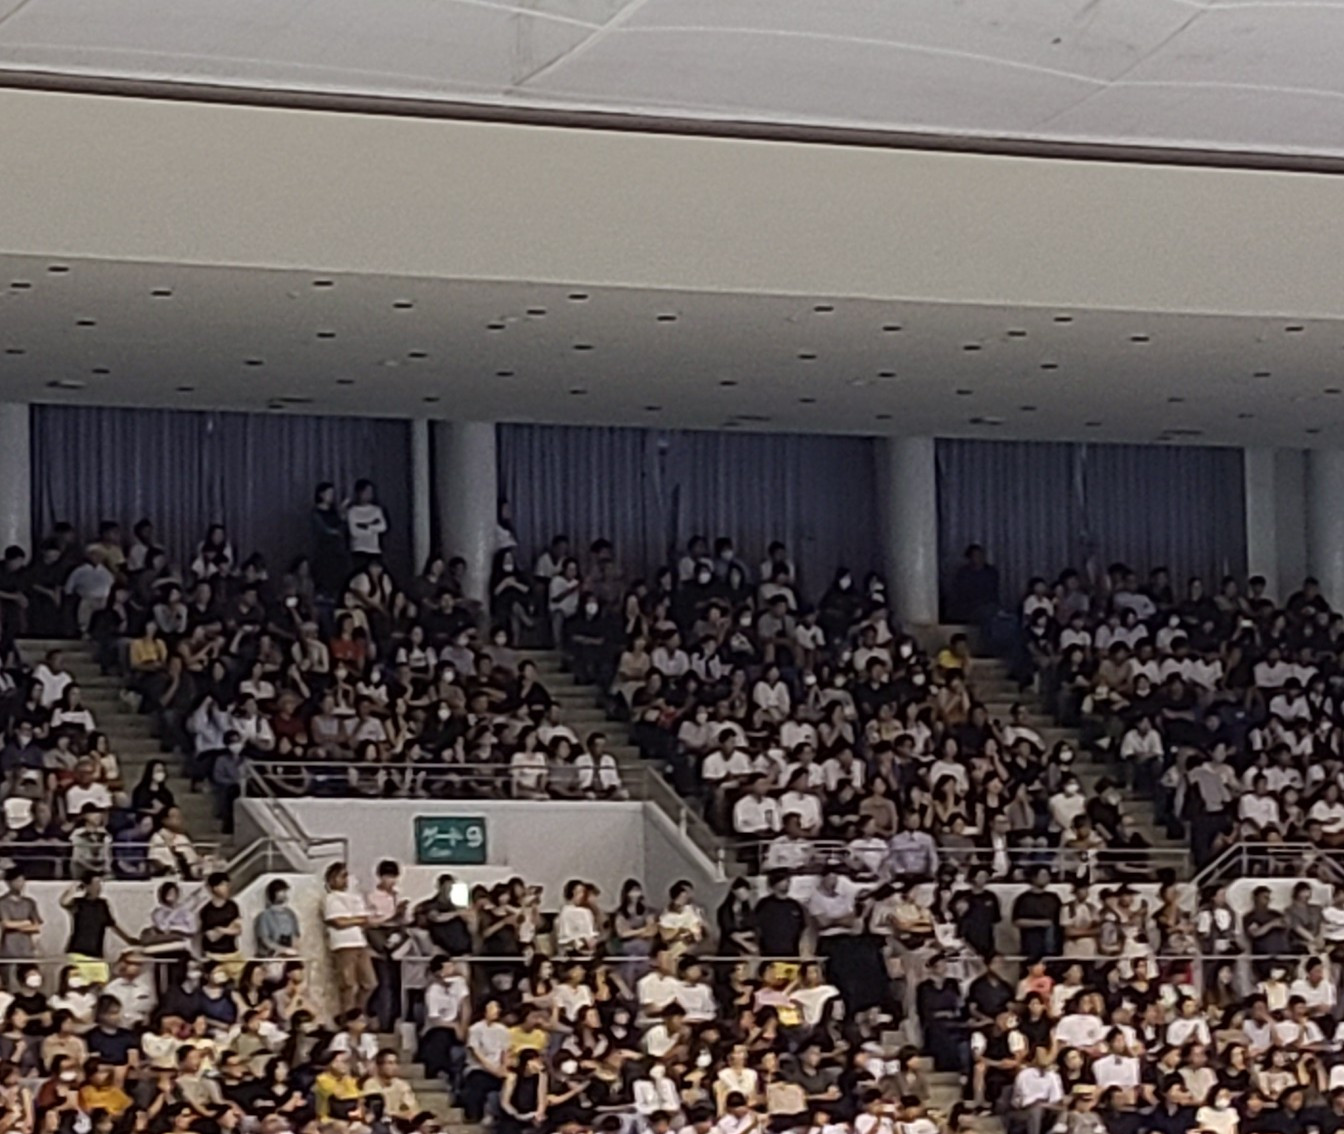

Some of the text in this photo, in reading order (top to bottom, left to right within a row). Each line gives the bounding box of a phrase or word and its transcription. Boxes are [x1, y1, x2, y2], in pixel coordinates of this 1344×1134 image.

[421, 825, 484, 849] ゲート 9
